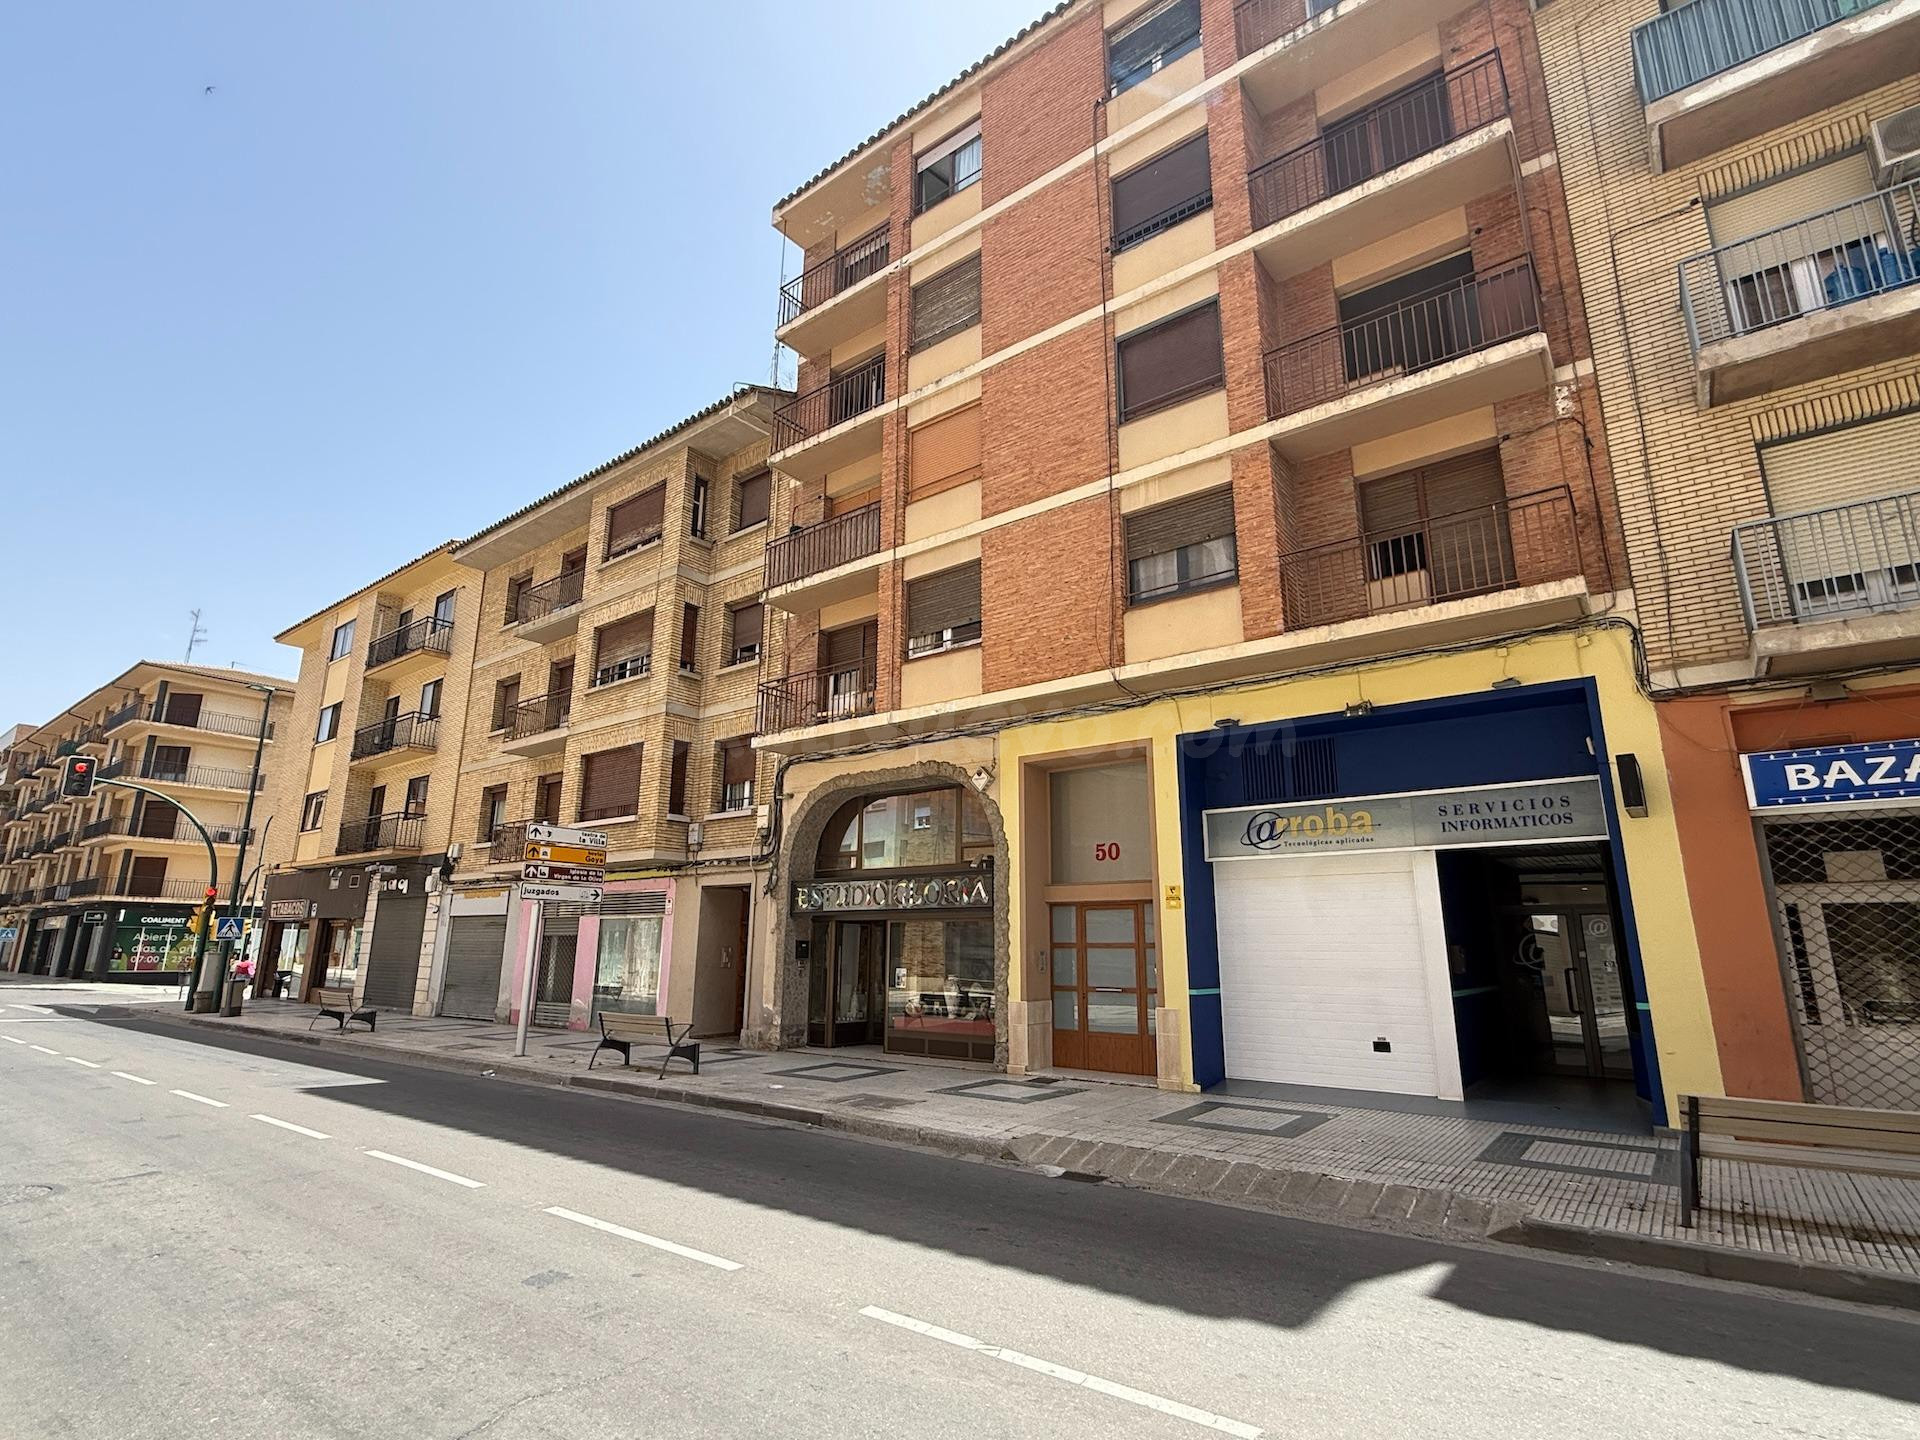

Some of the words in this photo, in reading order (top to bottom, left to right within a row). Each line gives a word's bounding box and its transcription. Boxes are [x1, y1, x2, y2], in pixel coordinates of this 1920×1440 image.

[1438, 796, 1570, 816] SERVICIOS
[1441, 812, 1573, 832] INFORMATICOS
[1335, 837, 1374, 846] aplicadas
[1096, 843, 1120, 861] 50
[586, 856, 603, 864] Goya
[524, 887, 559, 896] juzgados
[895, 876, 989, 908] GLORIA
[277, 902, 304, 914] TABACOS
[133, 933, 177, 941] Abierto
